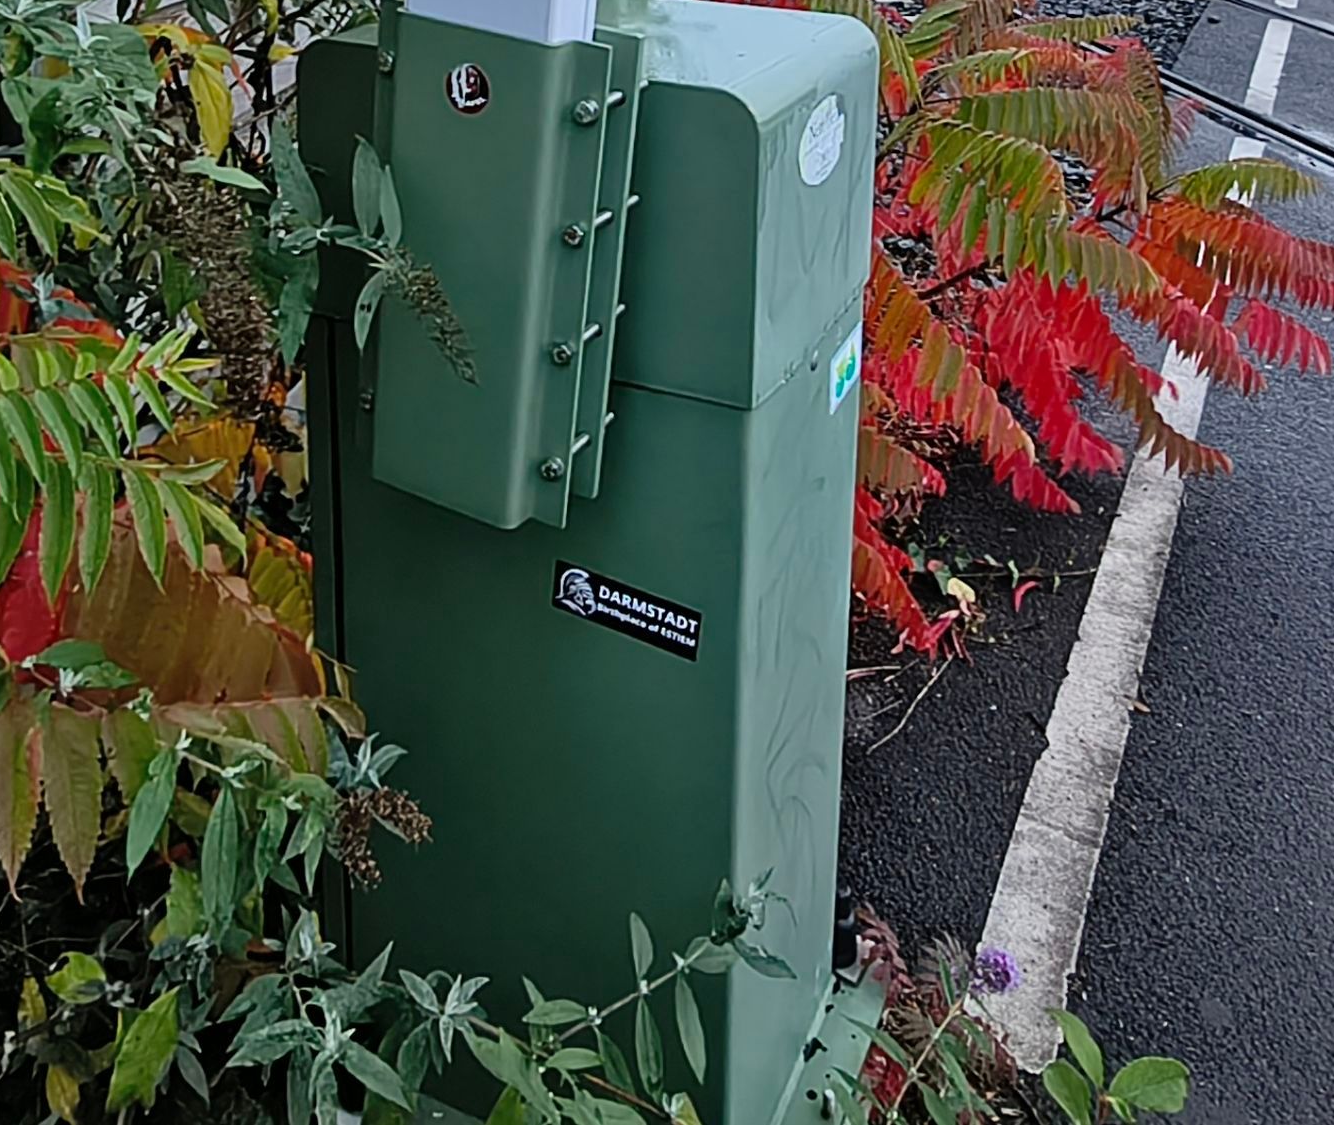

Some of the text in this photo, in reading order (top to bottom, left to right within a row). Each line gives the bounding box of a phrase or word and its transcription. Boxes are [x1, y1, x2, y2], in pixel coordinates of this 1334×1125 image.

[597, 603, 647, 628] Birthplace
[648, 624, 659, 633] of
[599, 585, 698, 633] DARMSTADT
